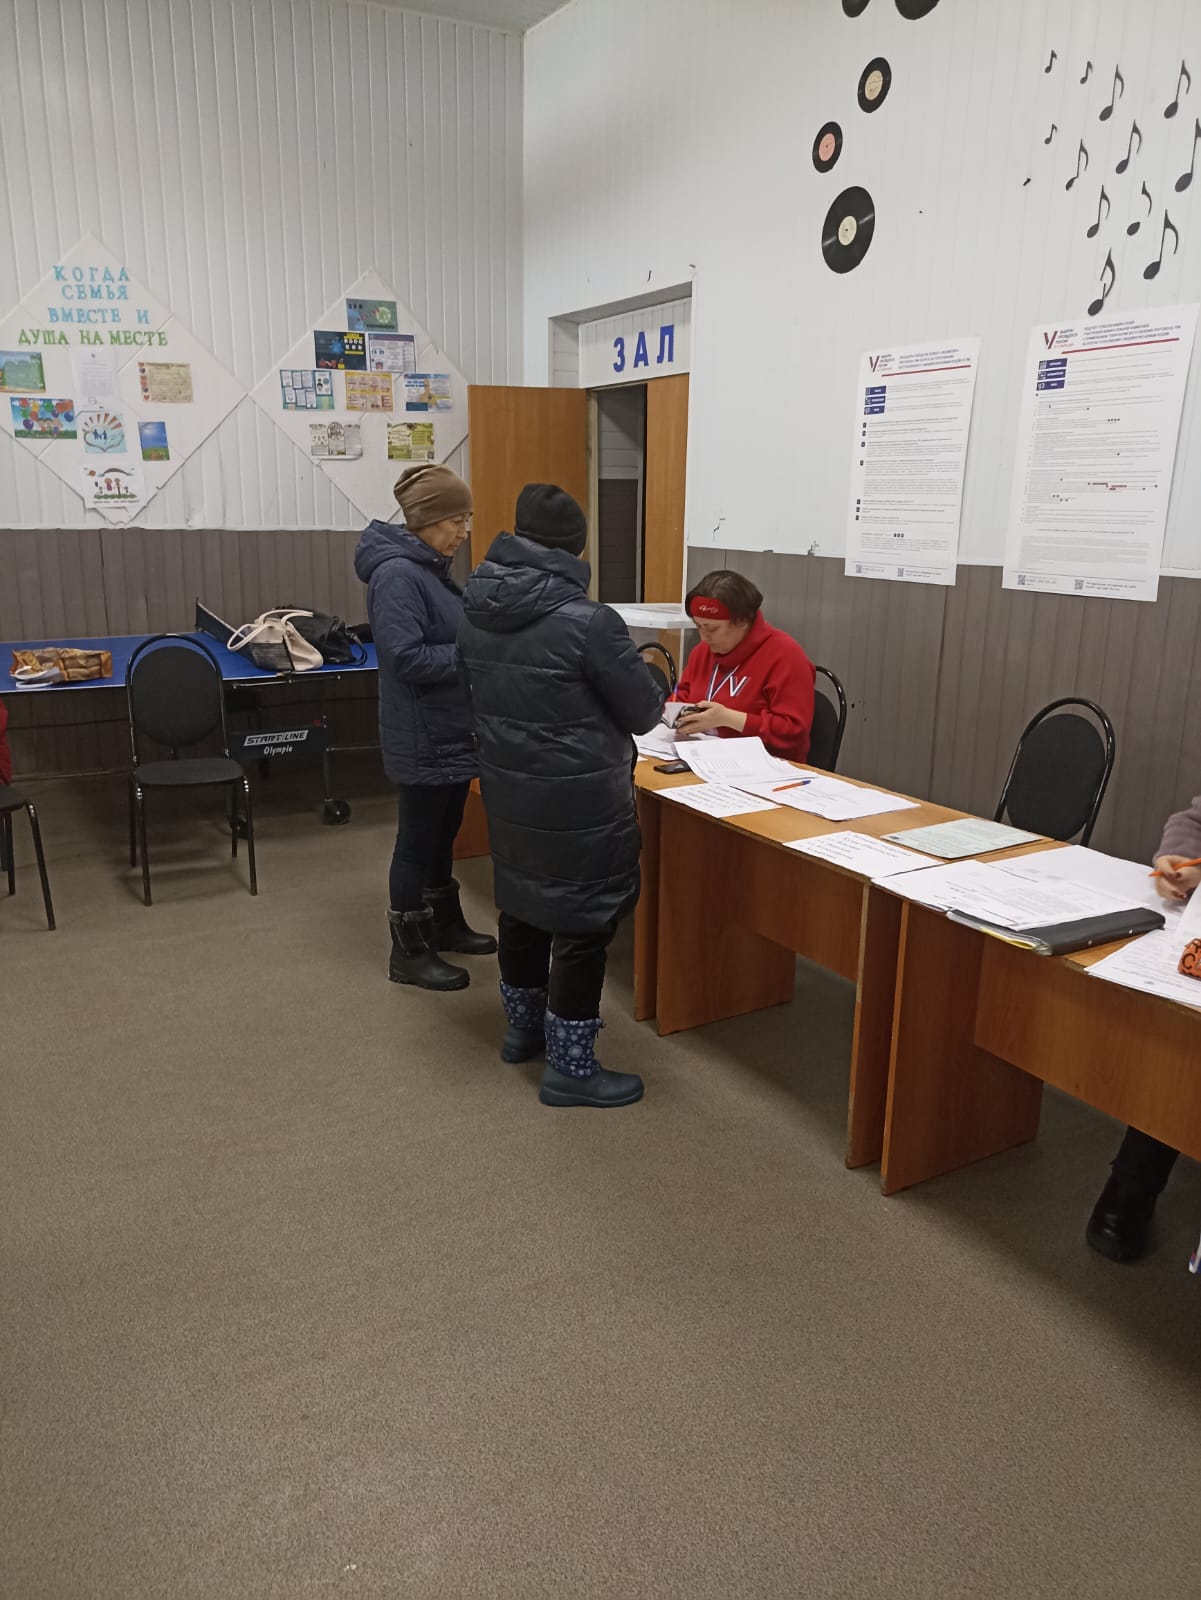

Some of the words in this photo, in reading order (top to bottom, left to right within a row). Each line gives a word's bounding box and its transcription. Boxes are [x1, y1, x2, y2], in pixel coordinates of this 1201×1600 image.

[53, 265, 131, 283] КОГДА
[61, 284, 129, 300] СЕМЬЯ
[48, 307, 122, 325] ВМЕСТЕ
[136, 308, 150, 325] И
[18, 328, 69, 345] ДУША
[79, 329, 104, 345] НА
[109, 330, 168, 347] МЕСТЕ
[613, 324, 675, 373] ЗАЛ
